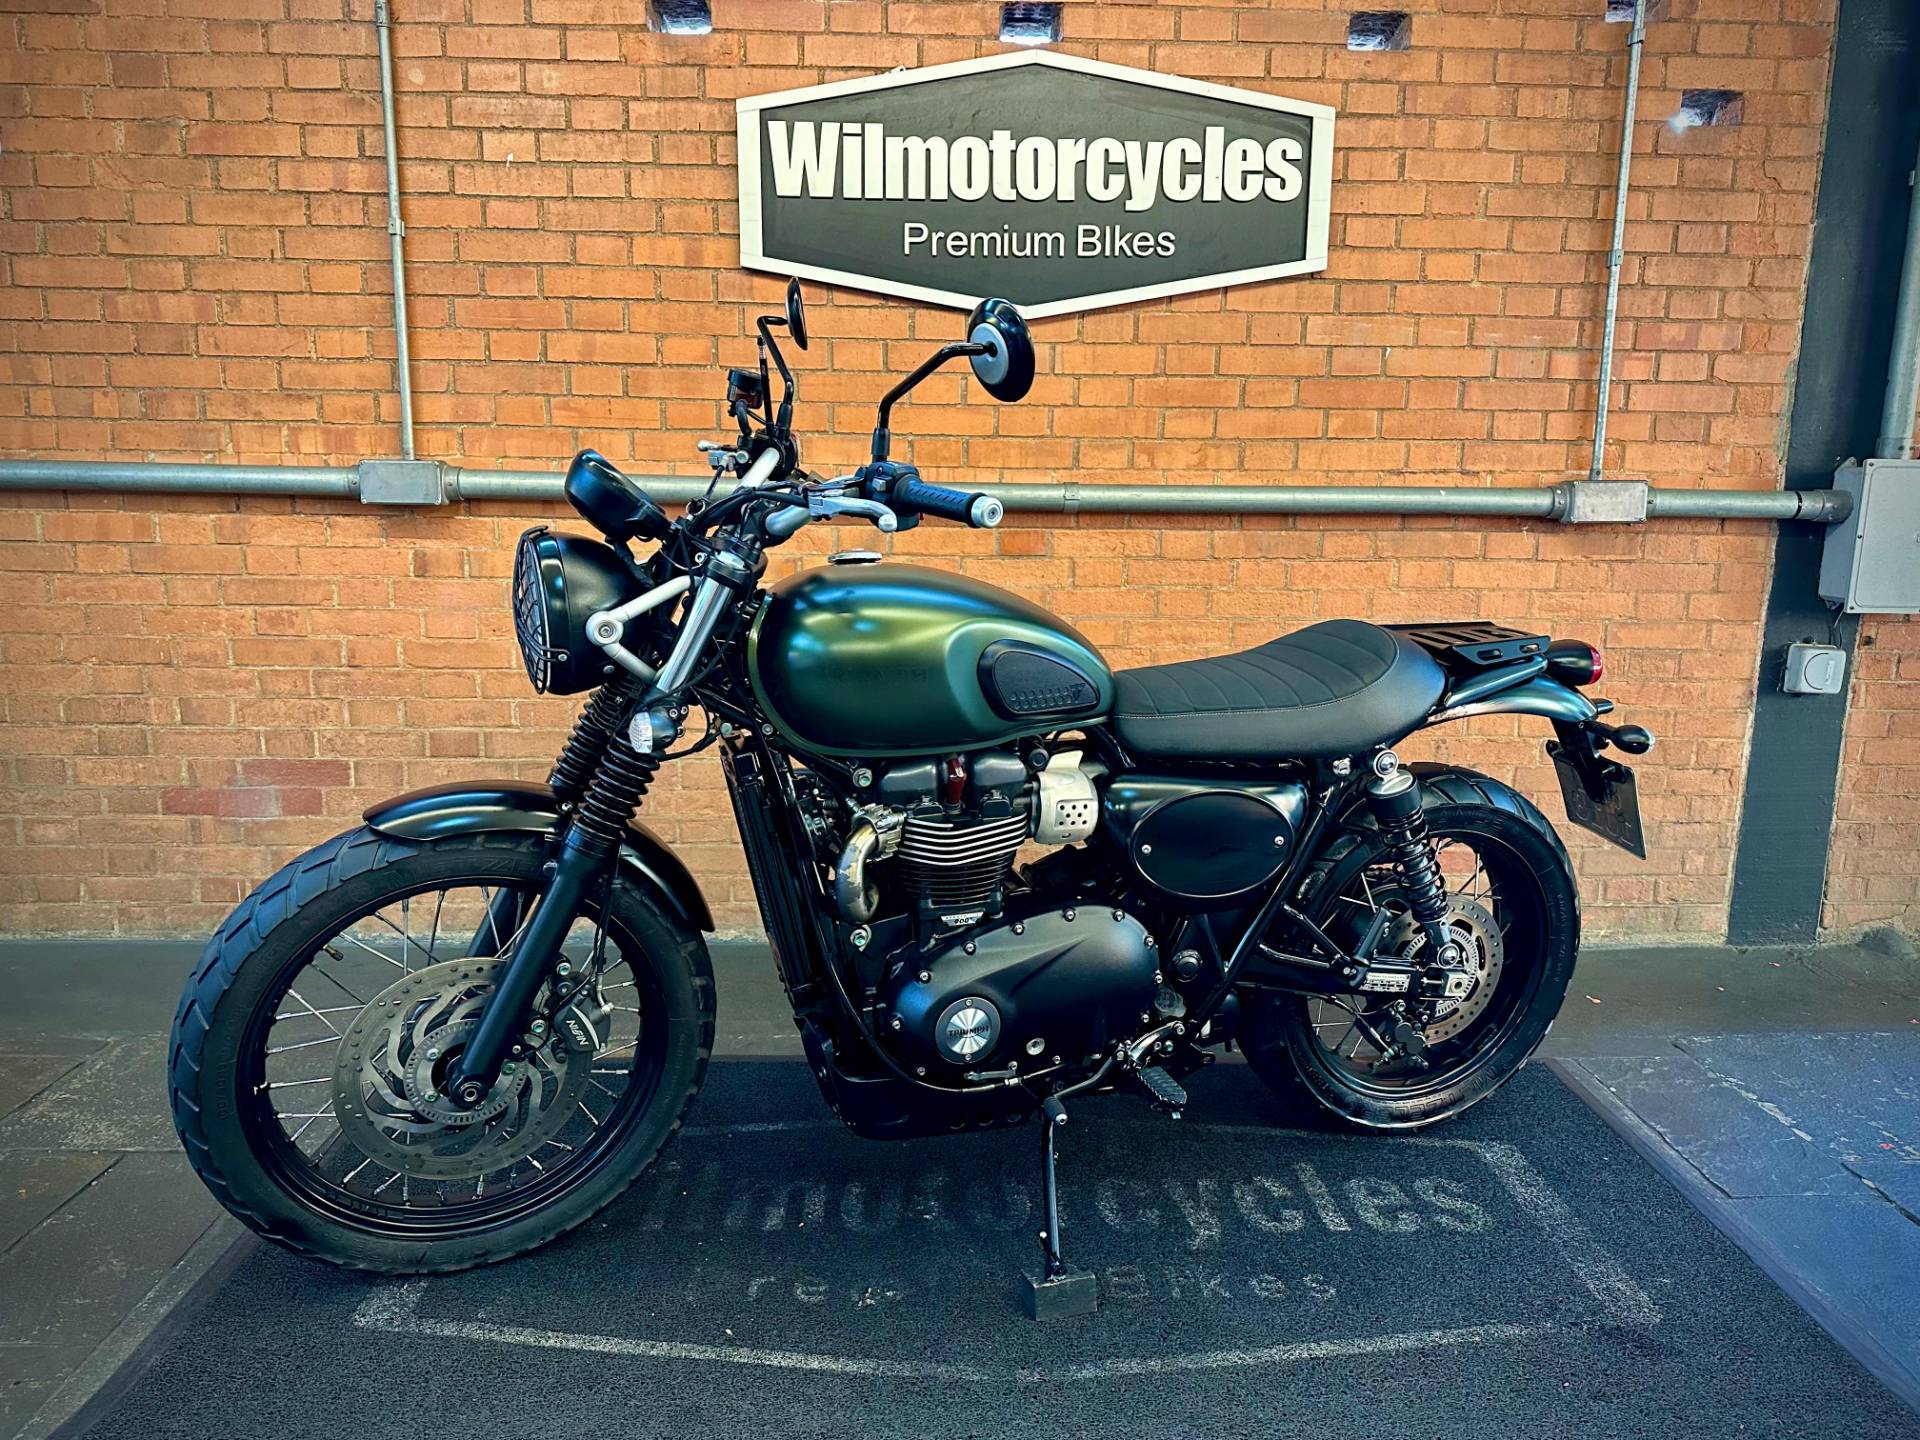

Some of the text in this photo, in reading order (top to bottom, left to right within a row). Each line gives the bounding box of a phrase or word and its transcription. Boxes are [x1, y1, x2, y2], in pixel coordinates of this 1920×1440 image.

[767, 120, 1304, 212] Wilmotorcycles
[903, 221, 1065, 257] Premium
[948, 1025, 989, 1037] TRIUMPH
